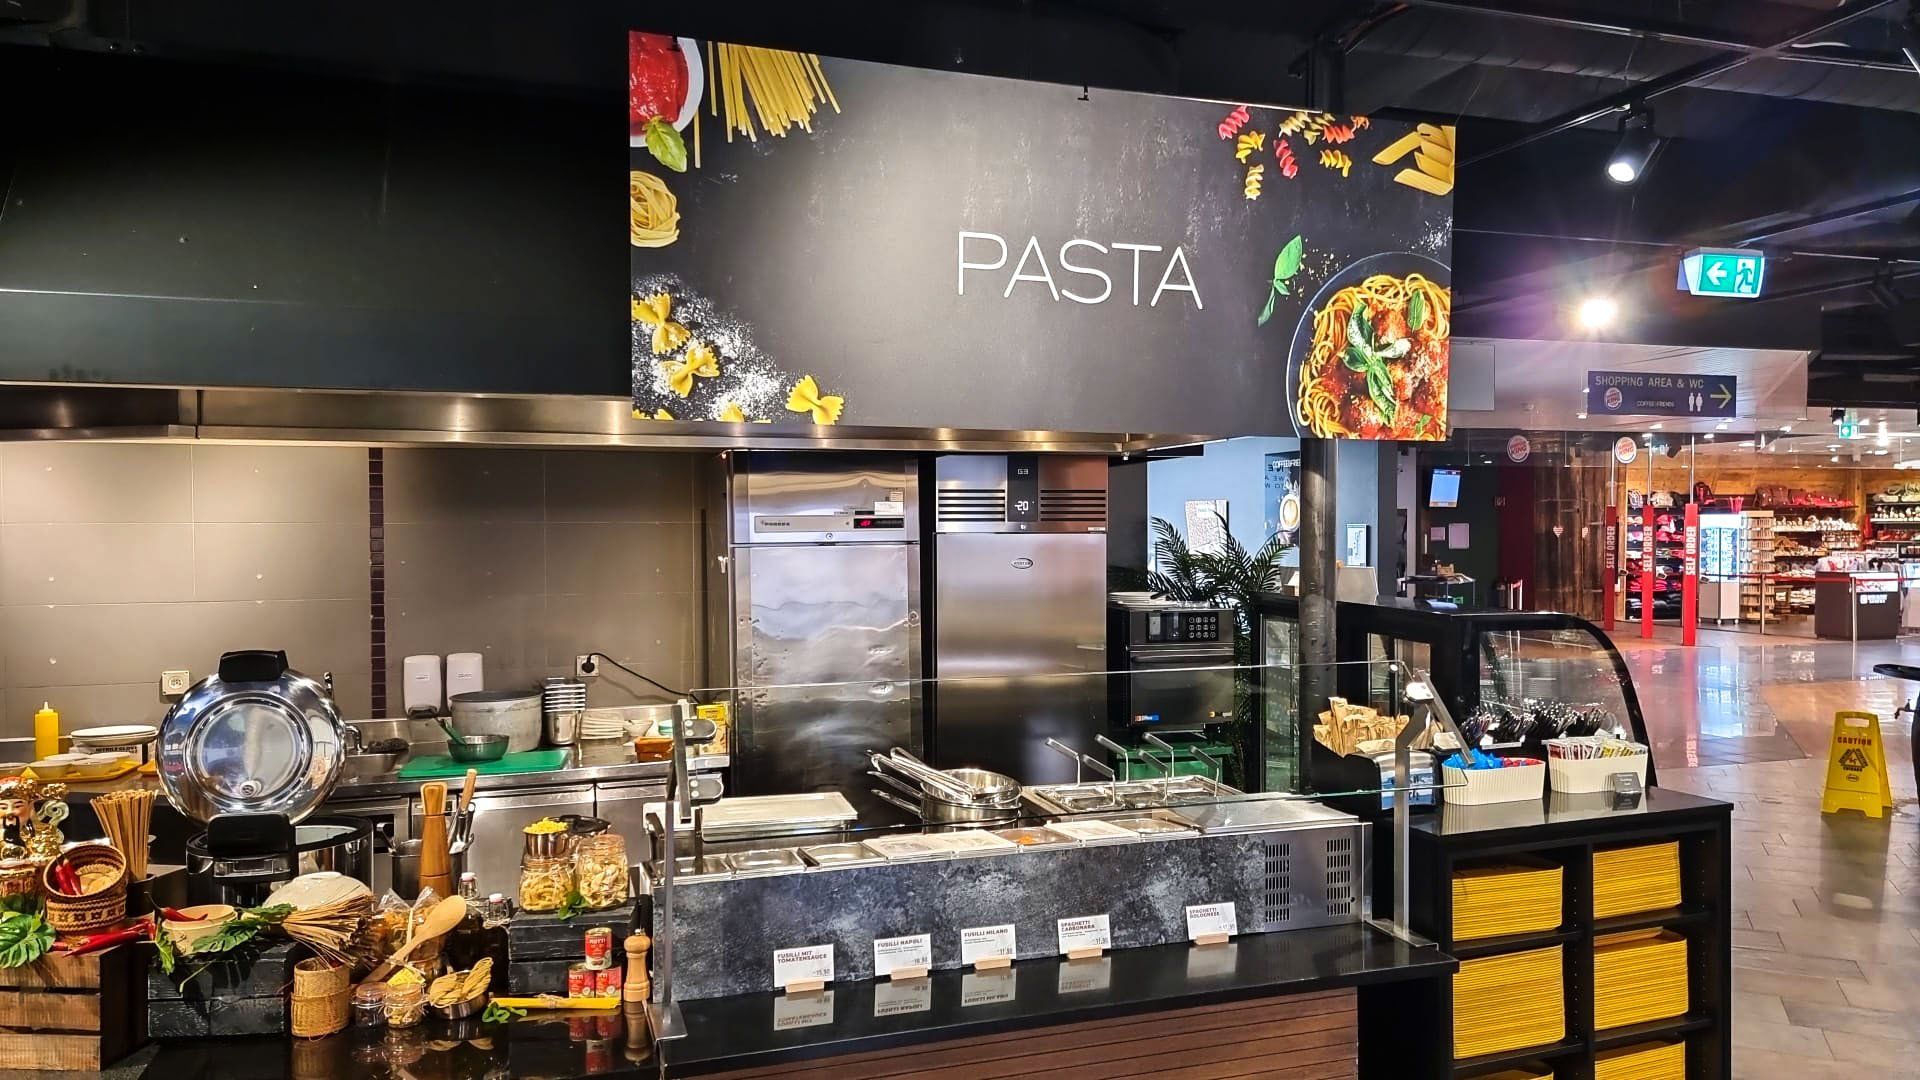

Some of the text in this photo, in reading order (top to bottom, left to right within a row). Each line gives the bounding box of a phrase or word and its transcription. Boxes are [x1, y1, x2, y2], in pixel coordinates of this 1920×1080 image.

[958, 231, 1204, 310] PASTA
[1595, 375, 1705, 389] SHOPPING AREA & WC
[1606, 526, 1616, 569] SELF ORDER
[1643, 526, 1653, 573] SELF ORDER
[1686, 526, 1698, 576] SELF ORDER
[1837, 736, 1872, 746] CAUTION
[1060, 920, 1091, 928] SPAGHETTI
[1061, 924, 1095, 933] CARBONARA
[964, 928, 1009, 938] FUSILLI MILANO
[877, 940, 899, 948] FUSILLI
[777, 951, 800, 959] FUSILLI
[777, 954, 828, 963] TOMATENSAUCE
